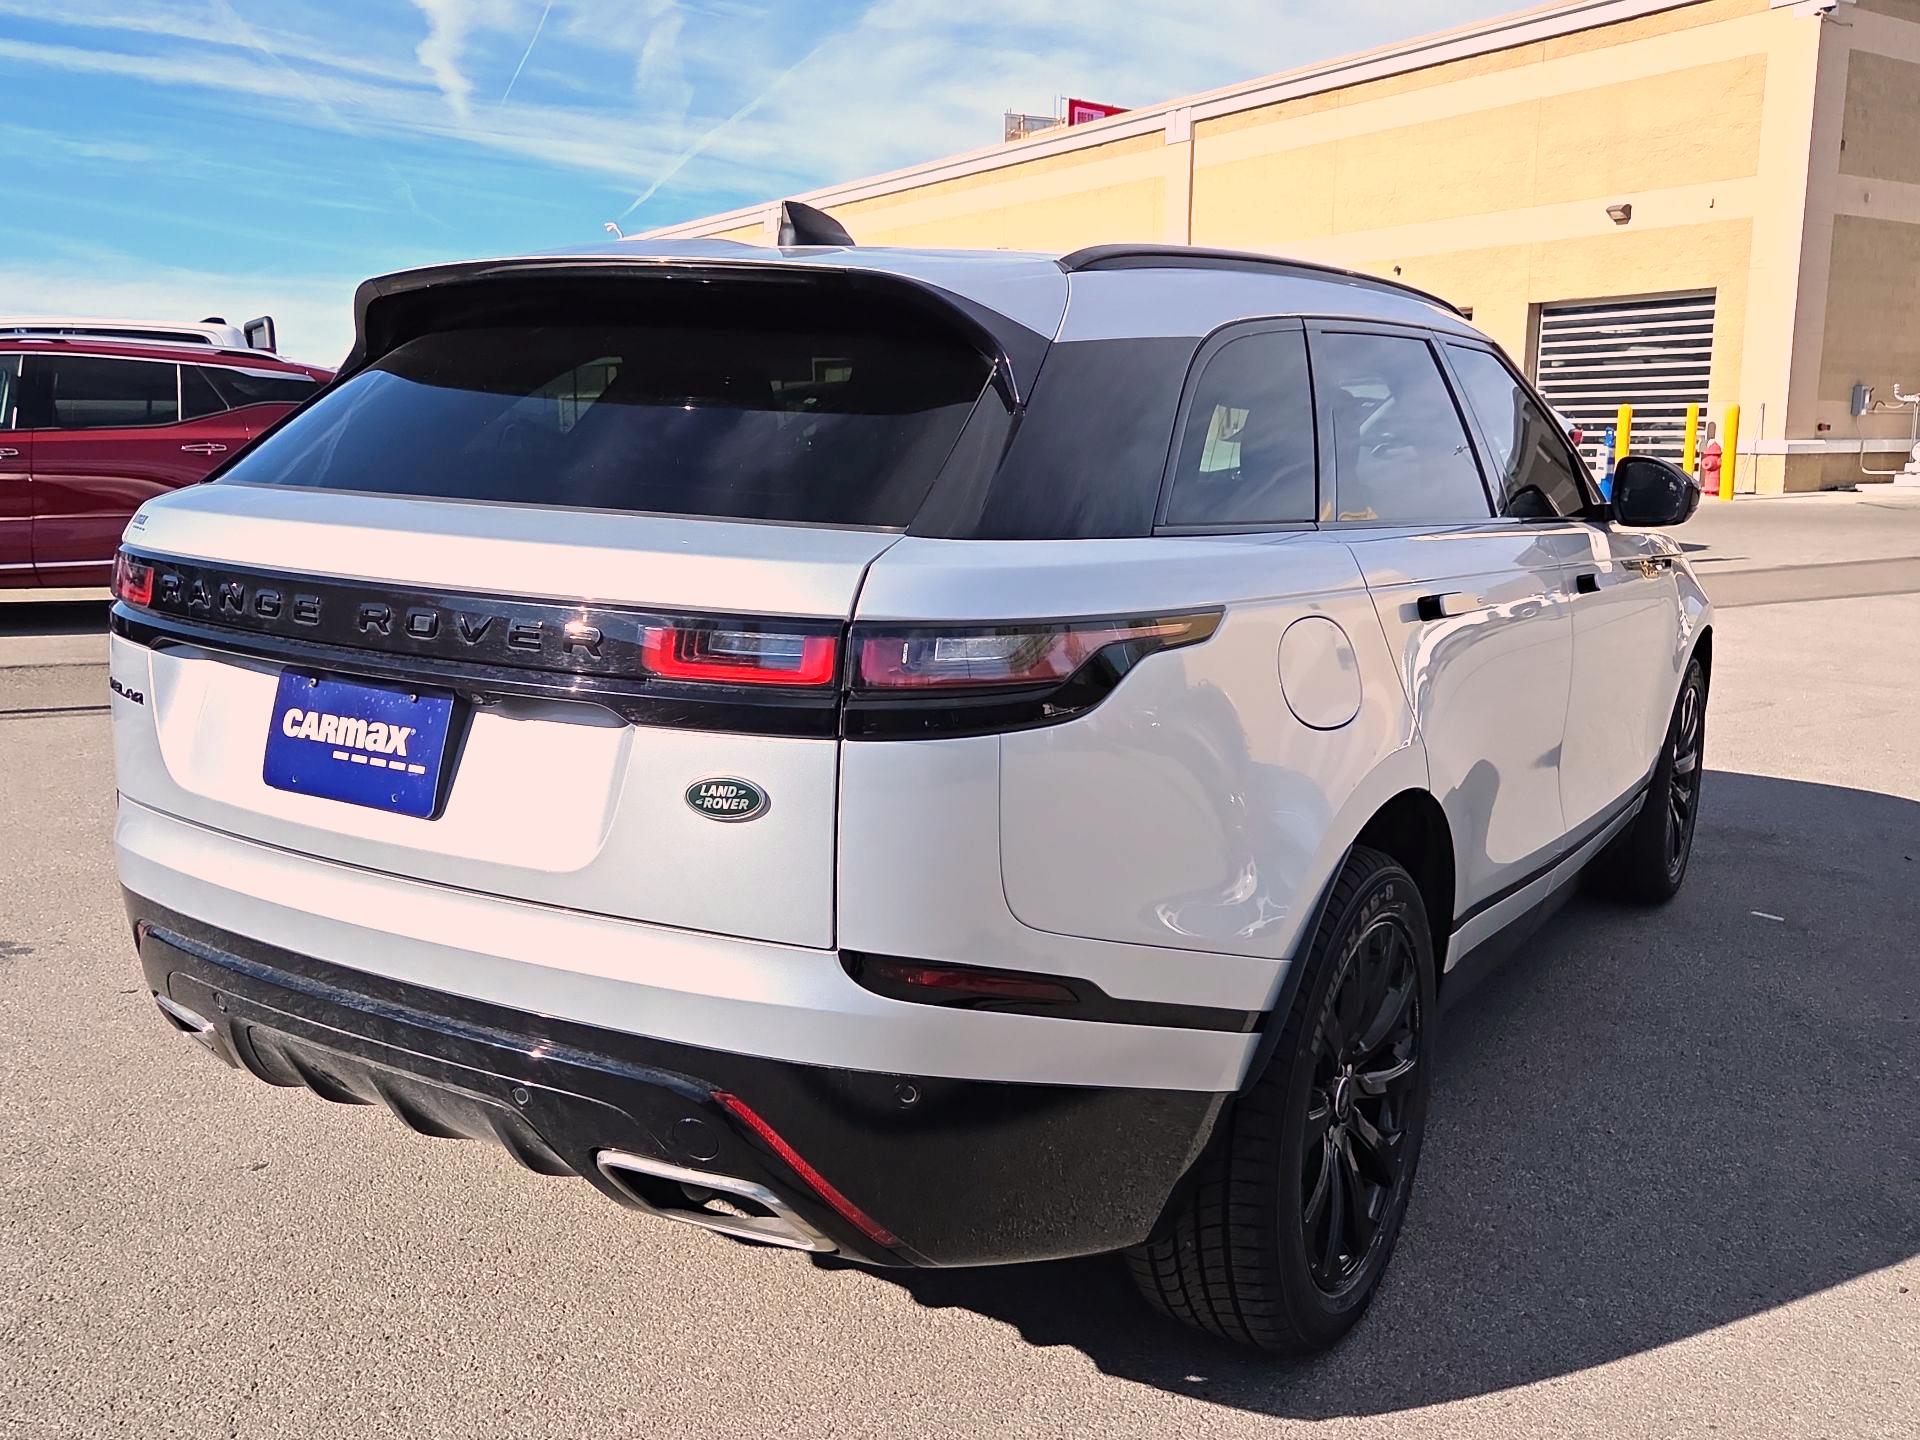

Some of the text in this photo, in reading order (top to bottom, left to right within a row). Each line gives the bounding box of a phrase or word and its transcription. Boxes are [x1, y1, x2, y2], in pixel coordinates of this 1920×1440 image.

[161, 574, 604, 659] RANGE ROVER
[700, 784, 738, 797] LAND
[703, 797, 749, 810] ROVER
